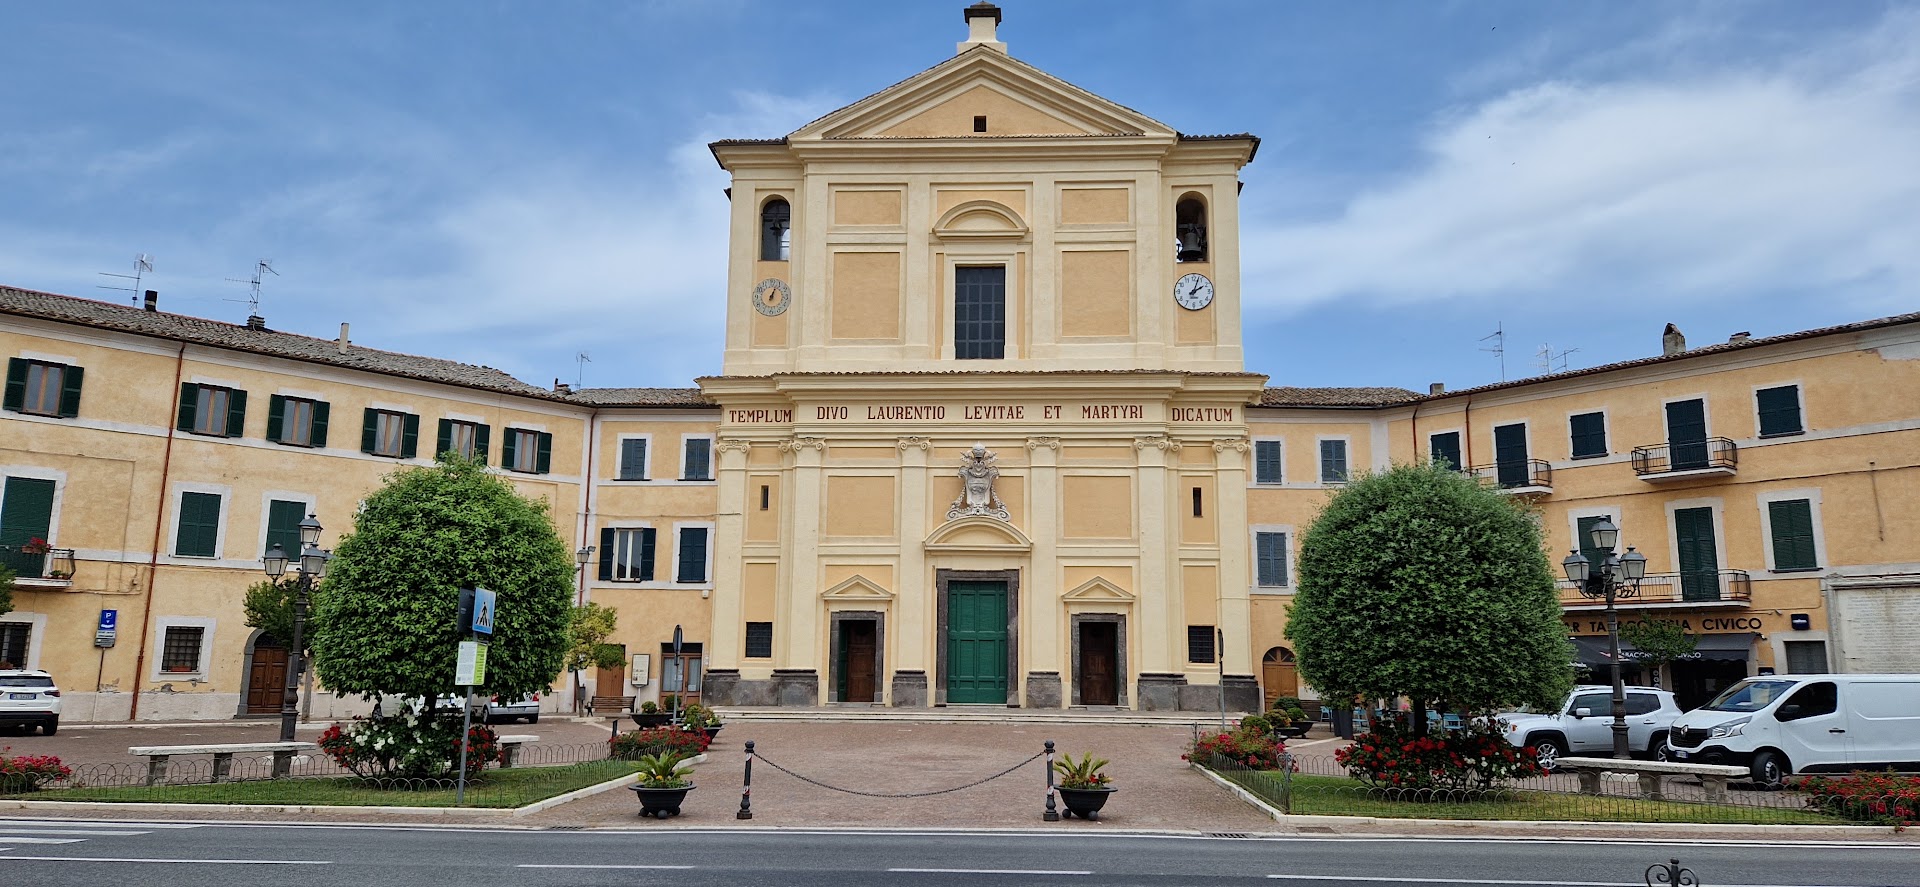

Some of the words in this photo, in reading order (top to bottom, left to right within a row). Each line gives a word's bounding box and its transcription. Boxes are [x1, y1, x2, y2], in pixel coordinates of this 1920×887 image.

[729, 410, 792, 423] TEMPLUM
[816, 406, 848, 420] DIVO
[867, 406, 945, 420] LAURENTIO
[964, 405, 1025, 420] LEVITAE
[1044, 405, 1062, 419] ET
[1082, 405, 1143, 419] MARTYRI
[1171, 407, 1233, 422] DICATUM
[1702, 617, 1762, 630] CIVICO
